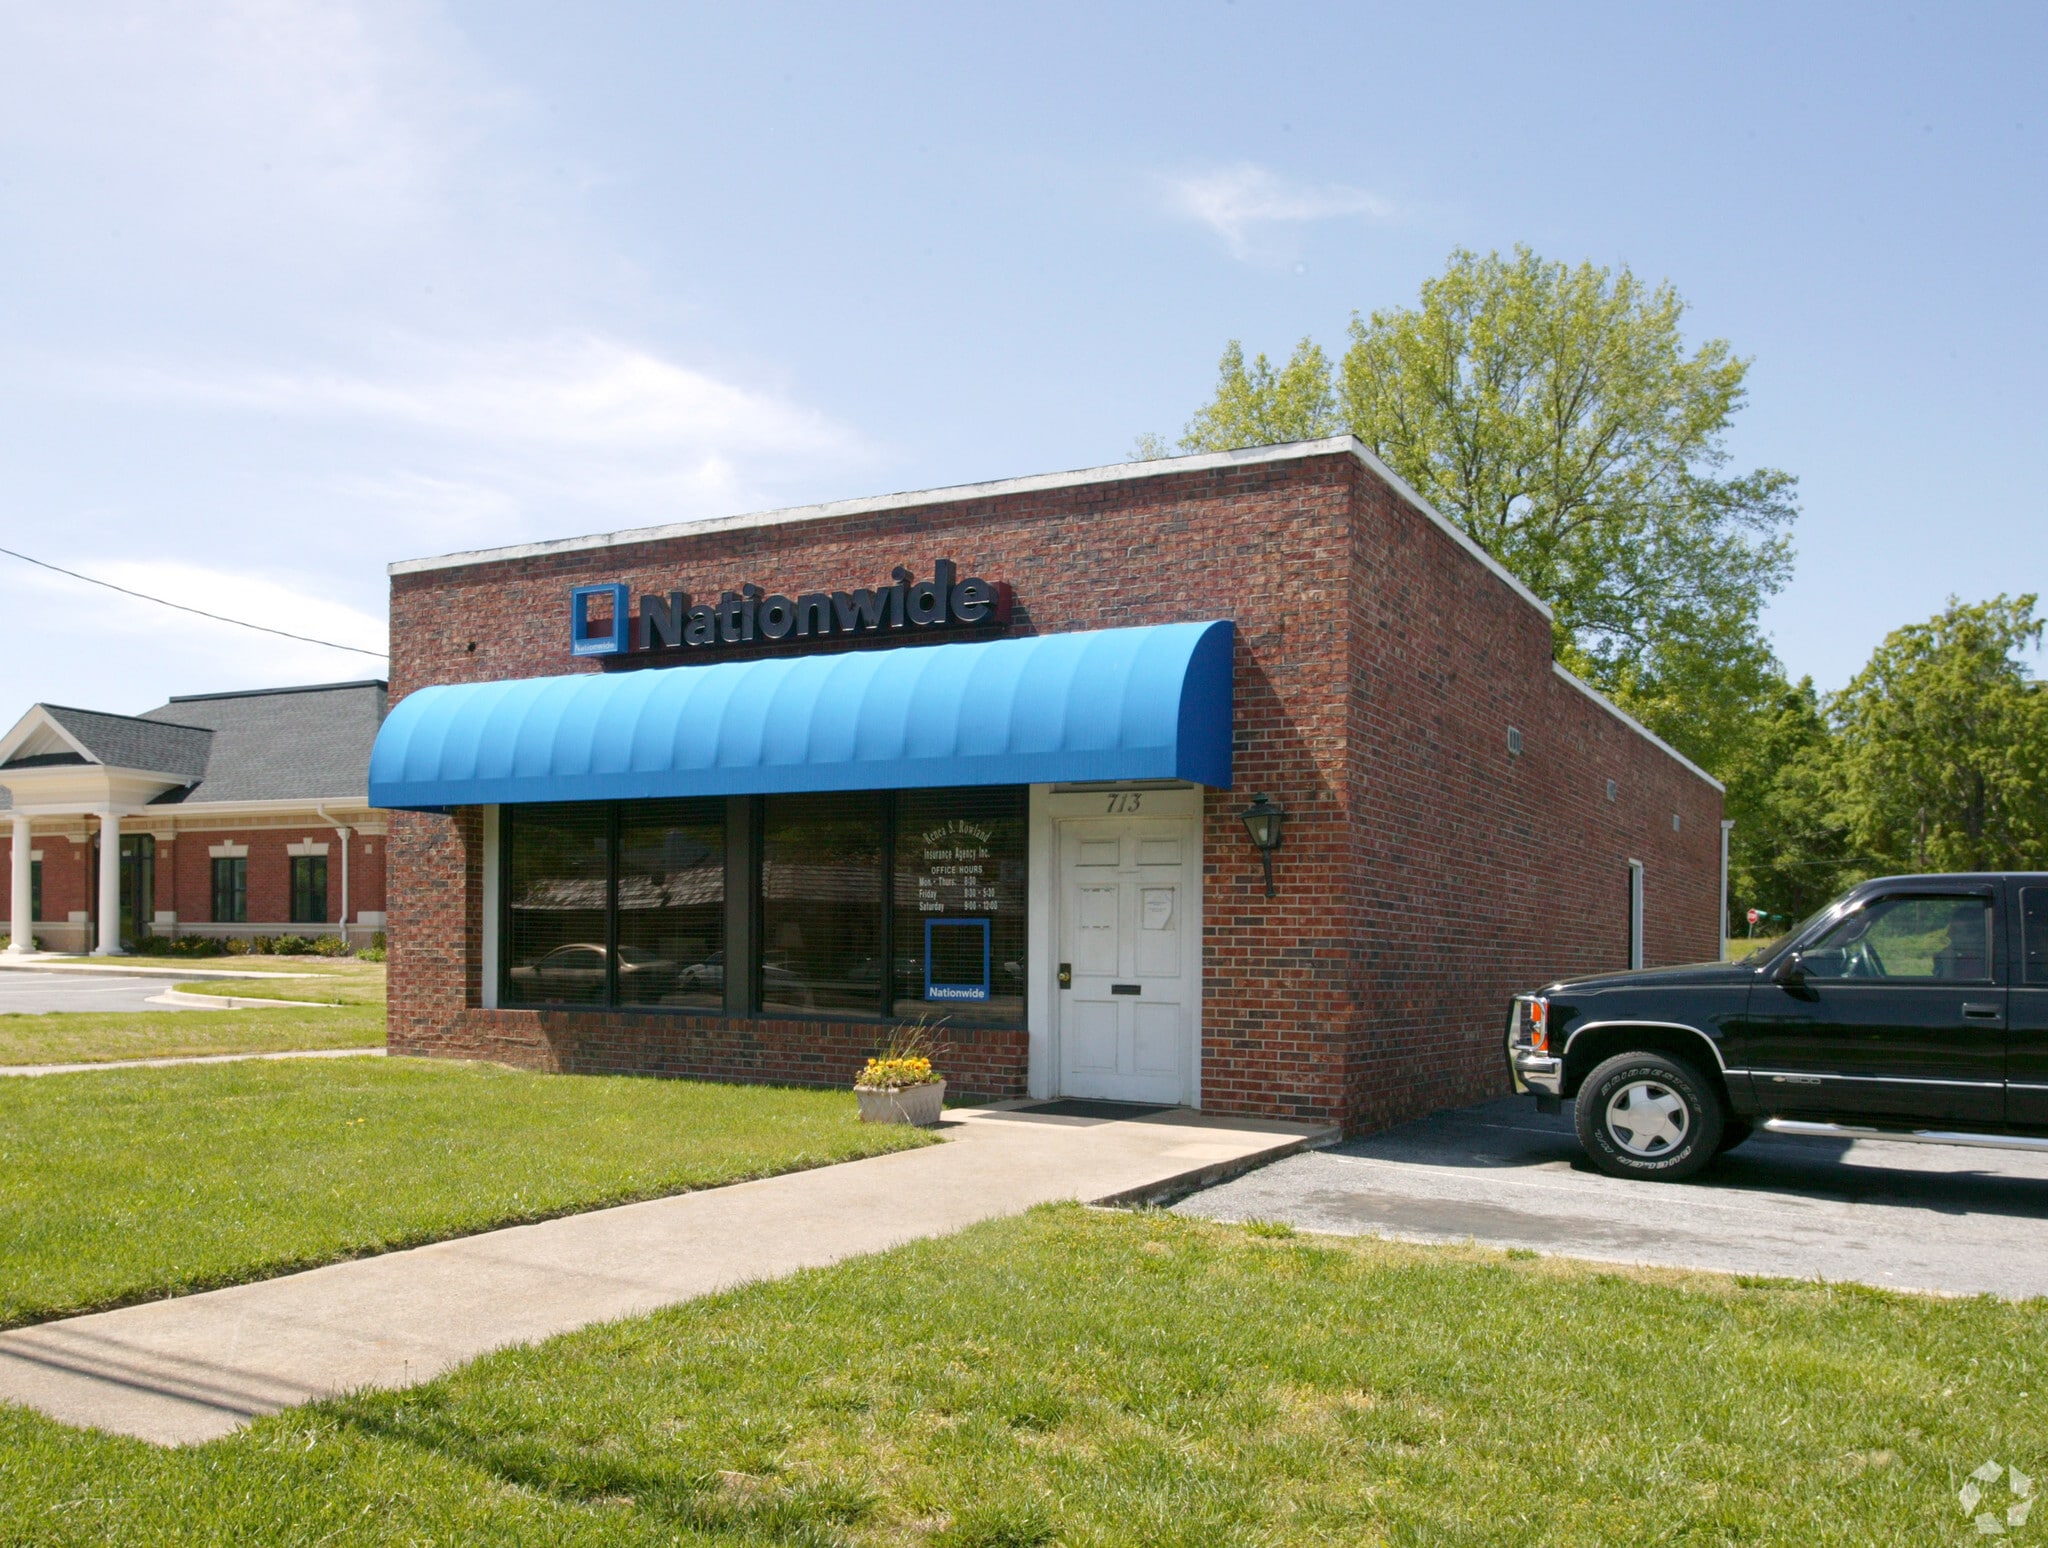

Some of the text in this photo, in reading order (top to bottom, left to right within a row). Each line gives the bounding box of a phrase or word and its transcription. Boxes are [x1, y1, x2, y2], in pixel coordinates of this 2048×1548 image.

[639, 559, 998, 650] Nationwide
[1106, 792, 1142, 813] 713
[959, 819, 993, 843] Rowland
[924, 845, 991, 862] Insurance Agency Inc.
[931, 865, 983, 875] OFFICE HOURS
[919, 888, 937, 900] Friday
[919, 901, 944, 913] Saturday
[983, 900, 998, 911] 12:00
[929, 987, 985, 998] Nationwide
[1601, 1067, 1702, 1114] BRIDGESTONE
